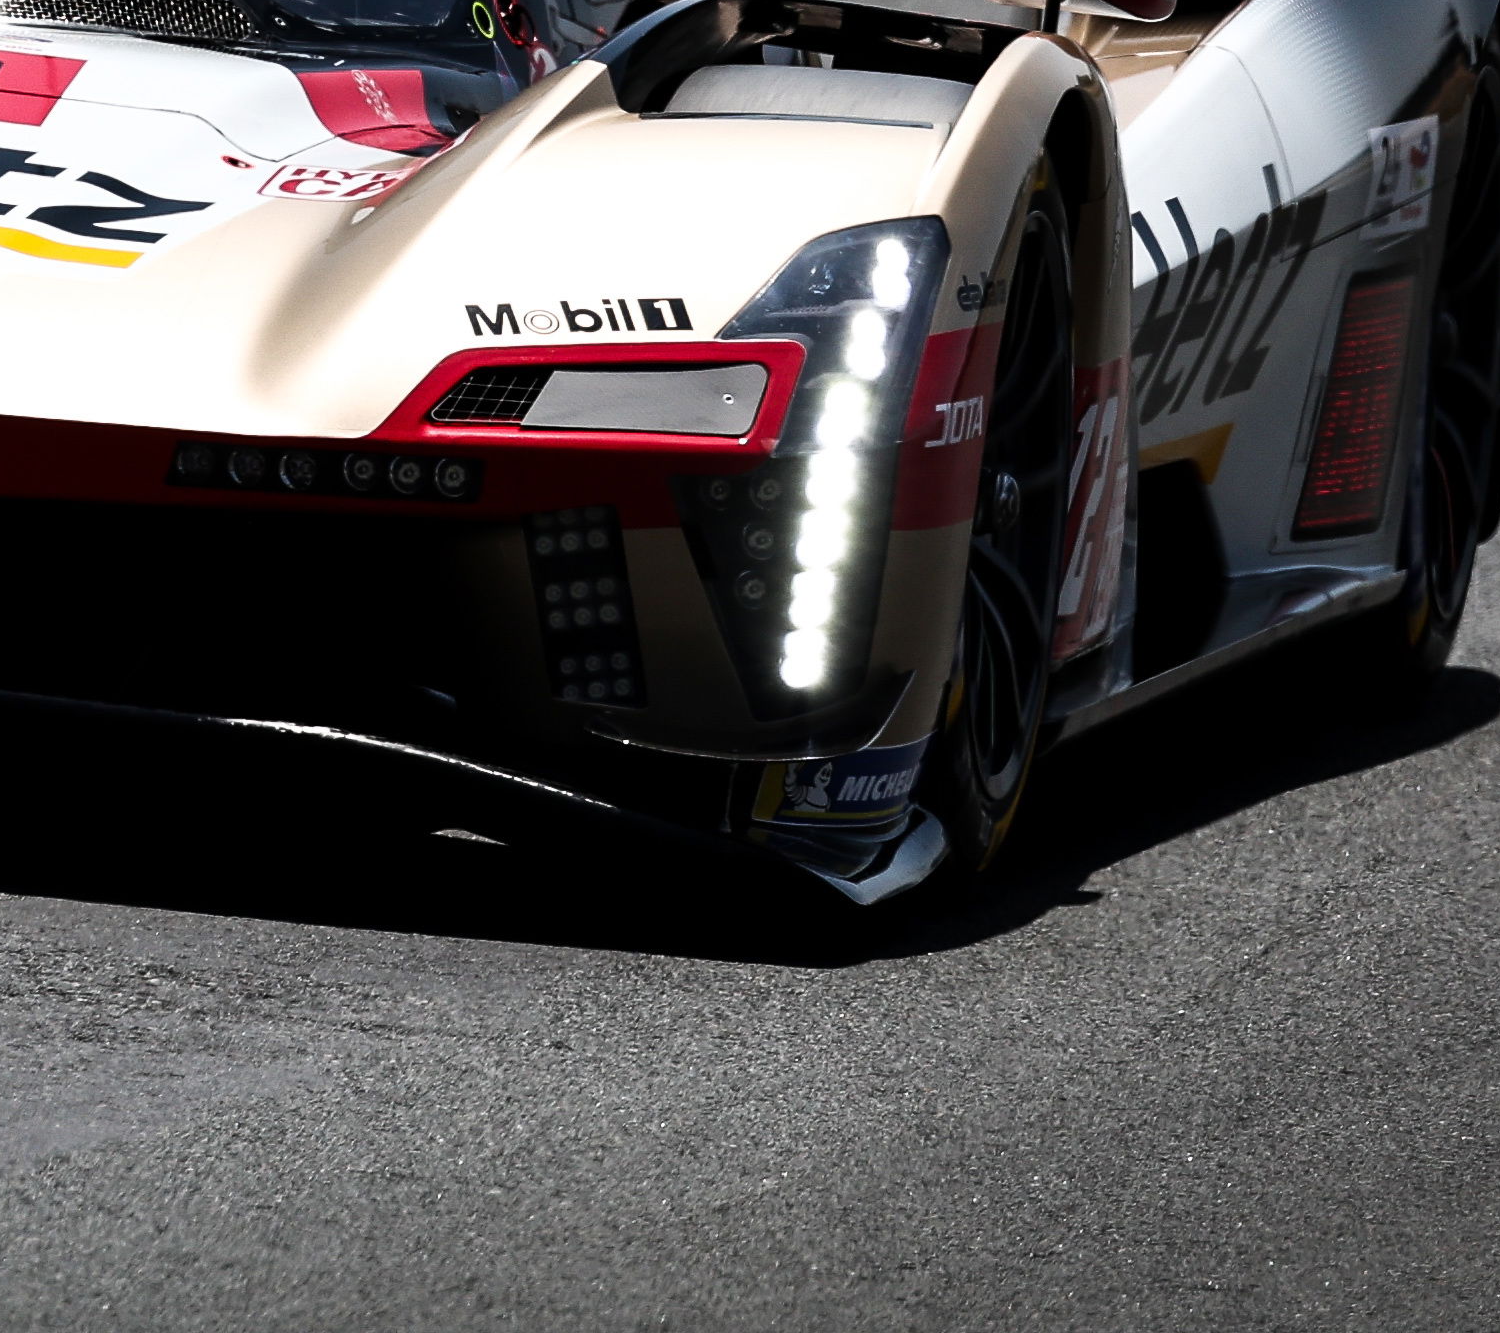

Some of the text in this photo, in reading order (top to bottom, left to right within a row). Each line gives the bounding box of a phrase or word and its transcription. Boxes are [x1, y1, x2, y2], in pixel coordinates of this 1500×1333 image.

[278, 179, 402, 198] CA
[464, 298, 637, 338] Mobil
[1131, 163, 1328, 426] Hertz
[924, 395, 984, 449] JOTA
